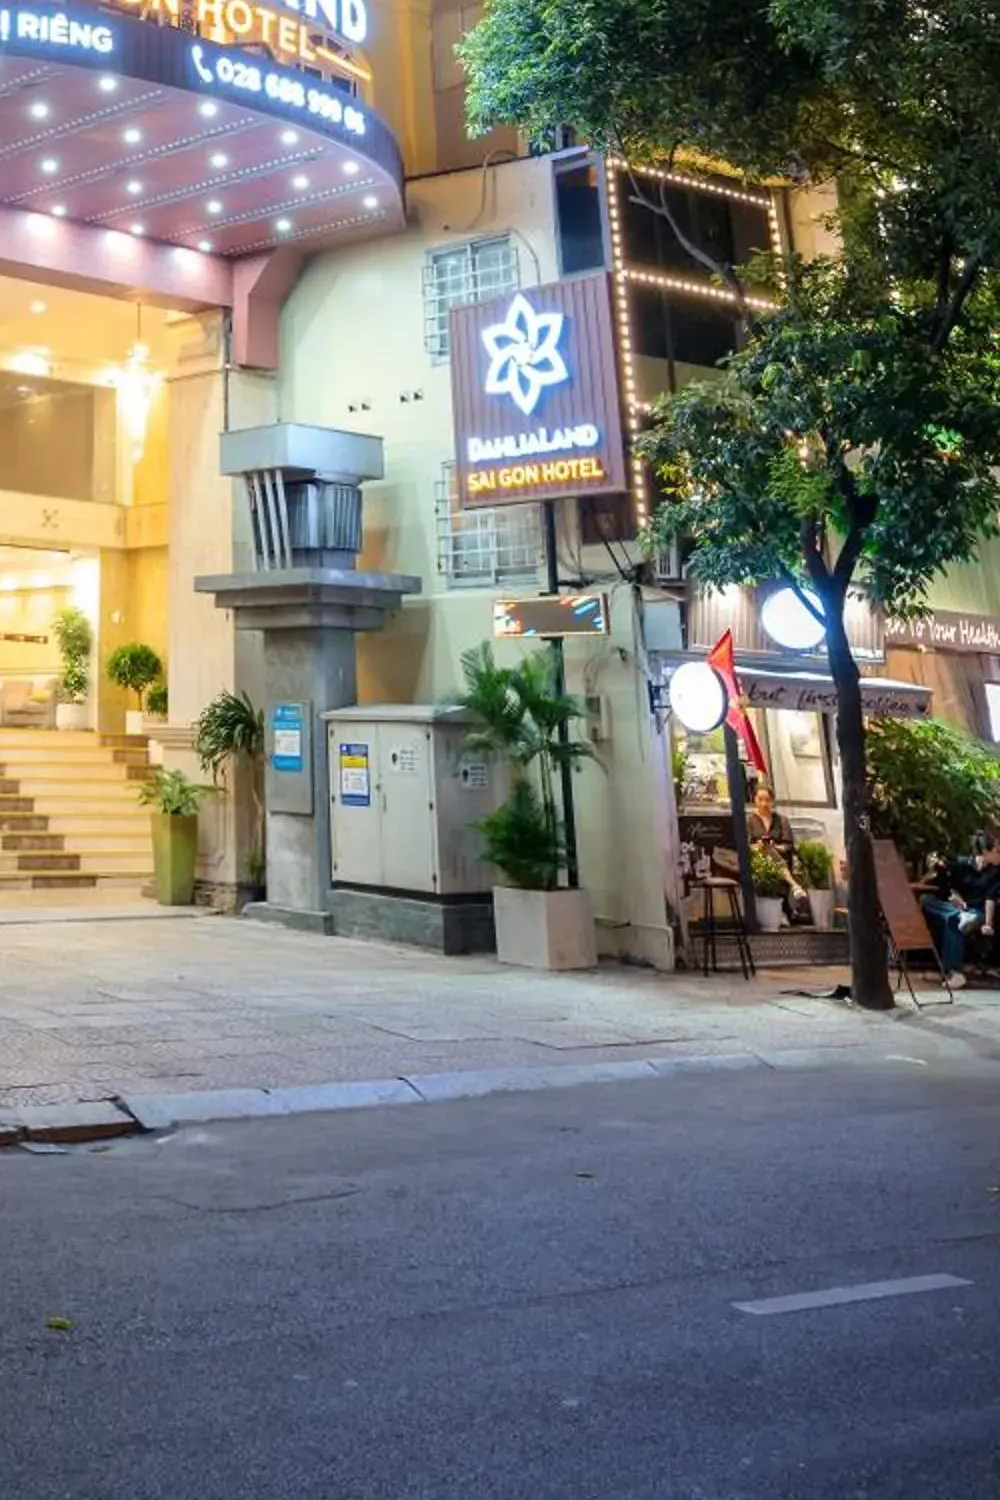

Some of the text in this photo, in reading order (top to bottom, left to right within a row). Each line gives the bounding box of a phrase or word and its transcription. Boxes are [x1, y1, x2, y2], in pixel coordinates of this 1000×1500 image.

[17, 12, 113, 53] RIÊNG
[468, 457, 604, 491] SAI GON HOTEL
[796, 688, 839, 710] firs
